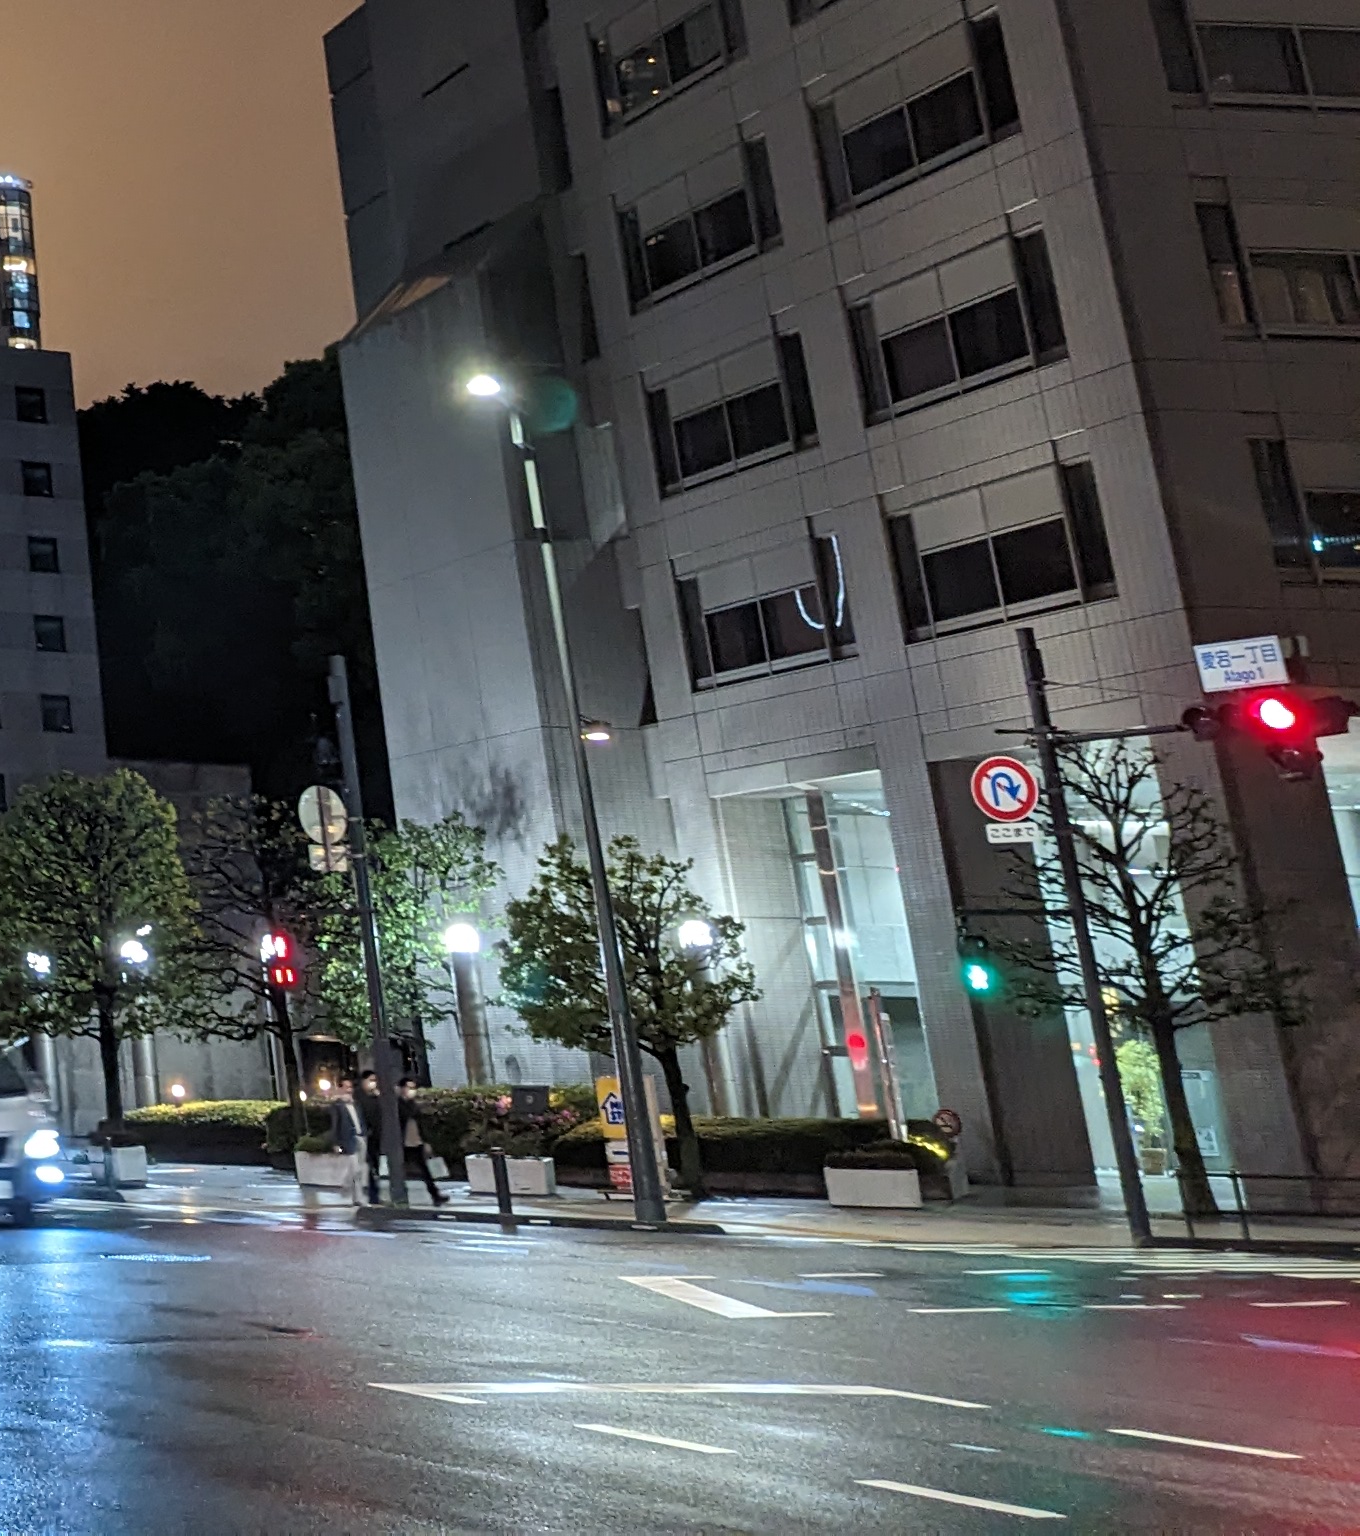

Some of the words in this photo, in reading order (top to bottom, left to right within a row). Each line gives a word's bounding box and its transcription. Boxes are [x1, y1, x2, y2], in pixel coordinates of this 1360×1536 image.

[1200, 643, 1278, 670] 愛宕一丁目
[1224, 669, 1256, 683] Atago
[1257, 667, 1265, 679] 1
[990, 826, 1035, 839] ここまで
